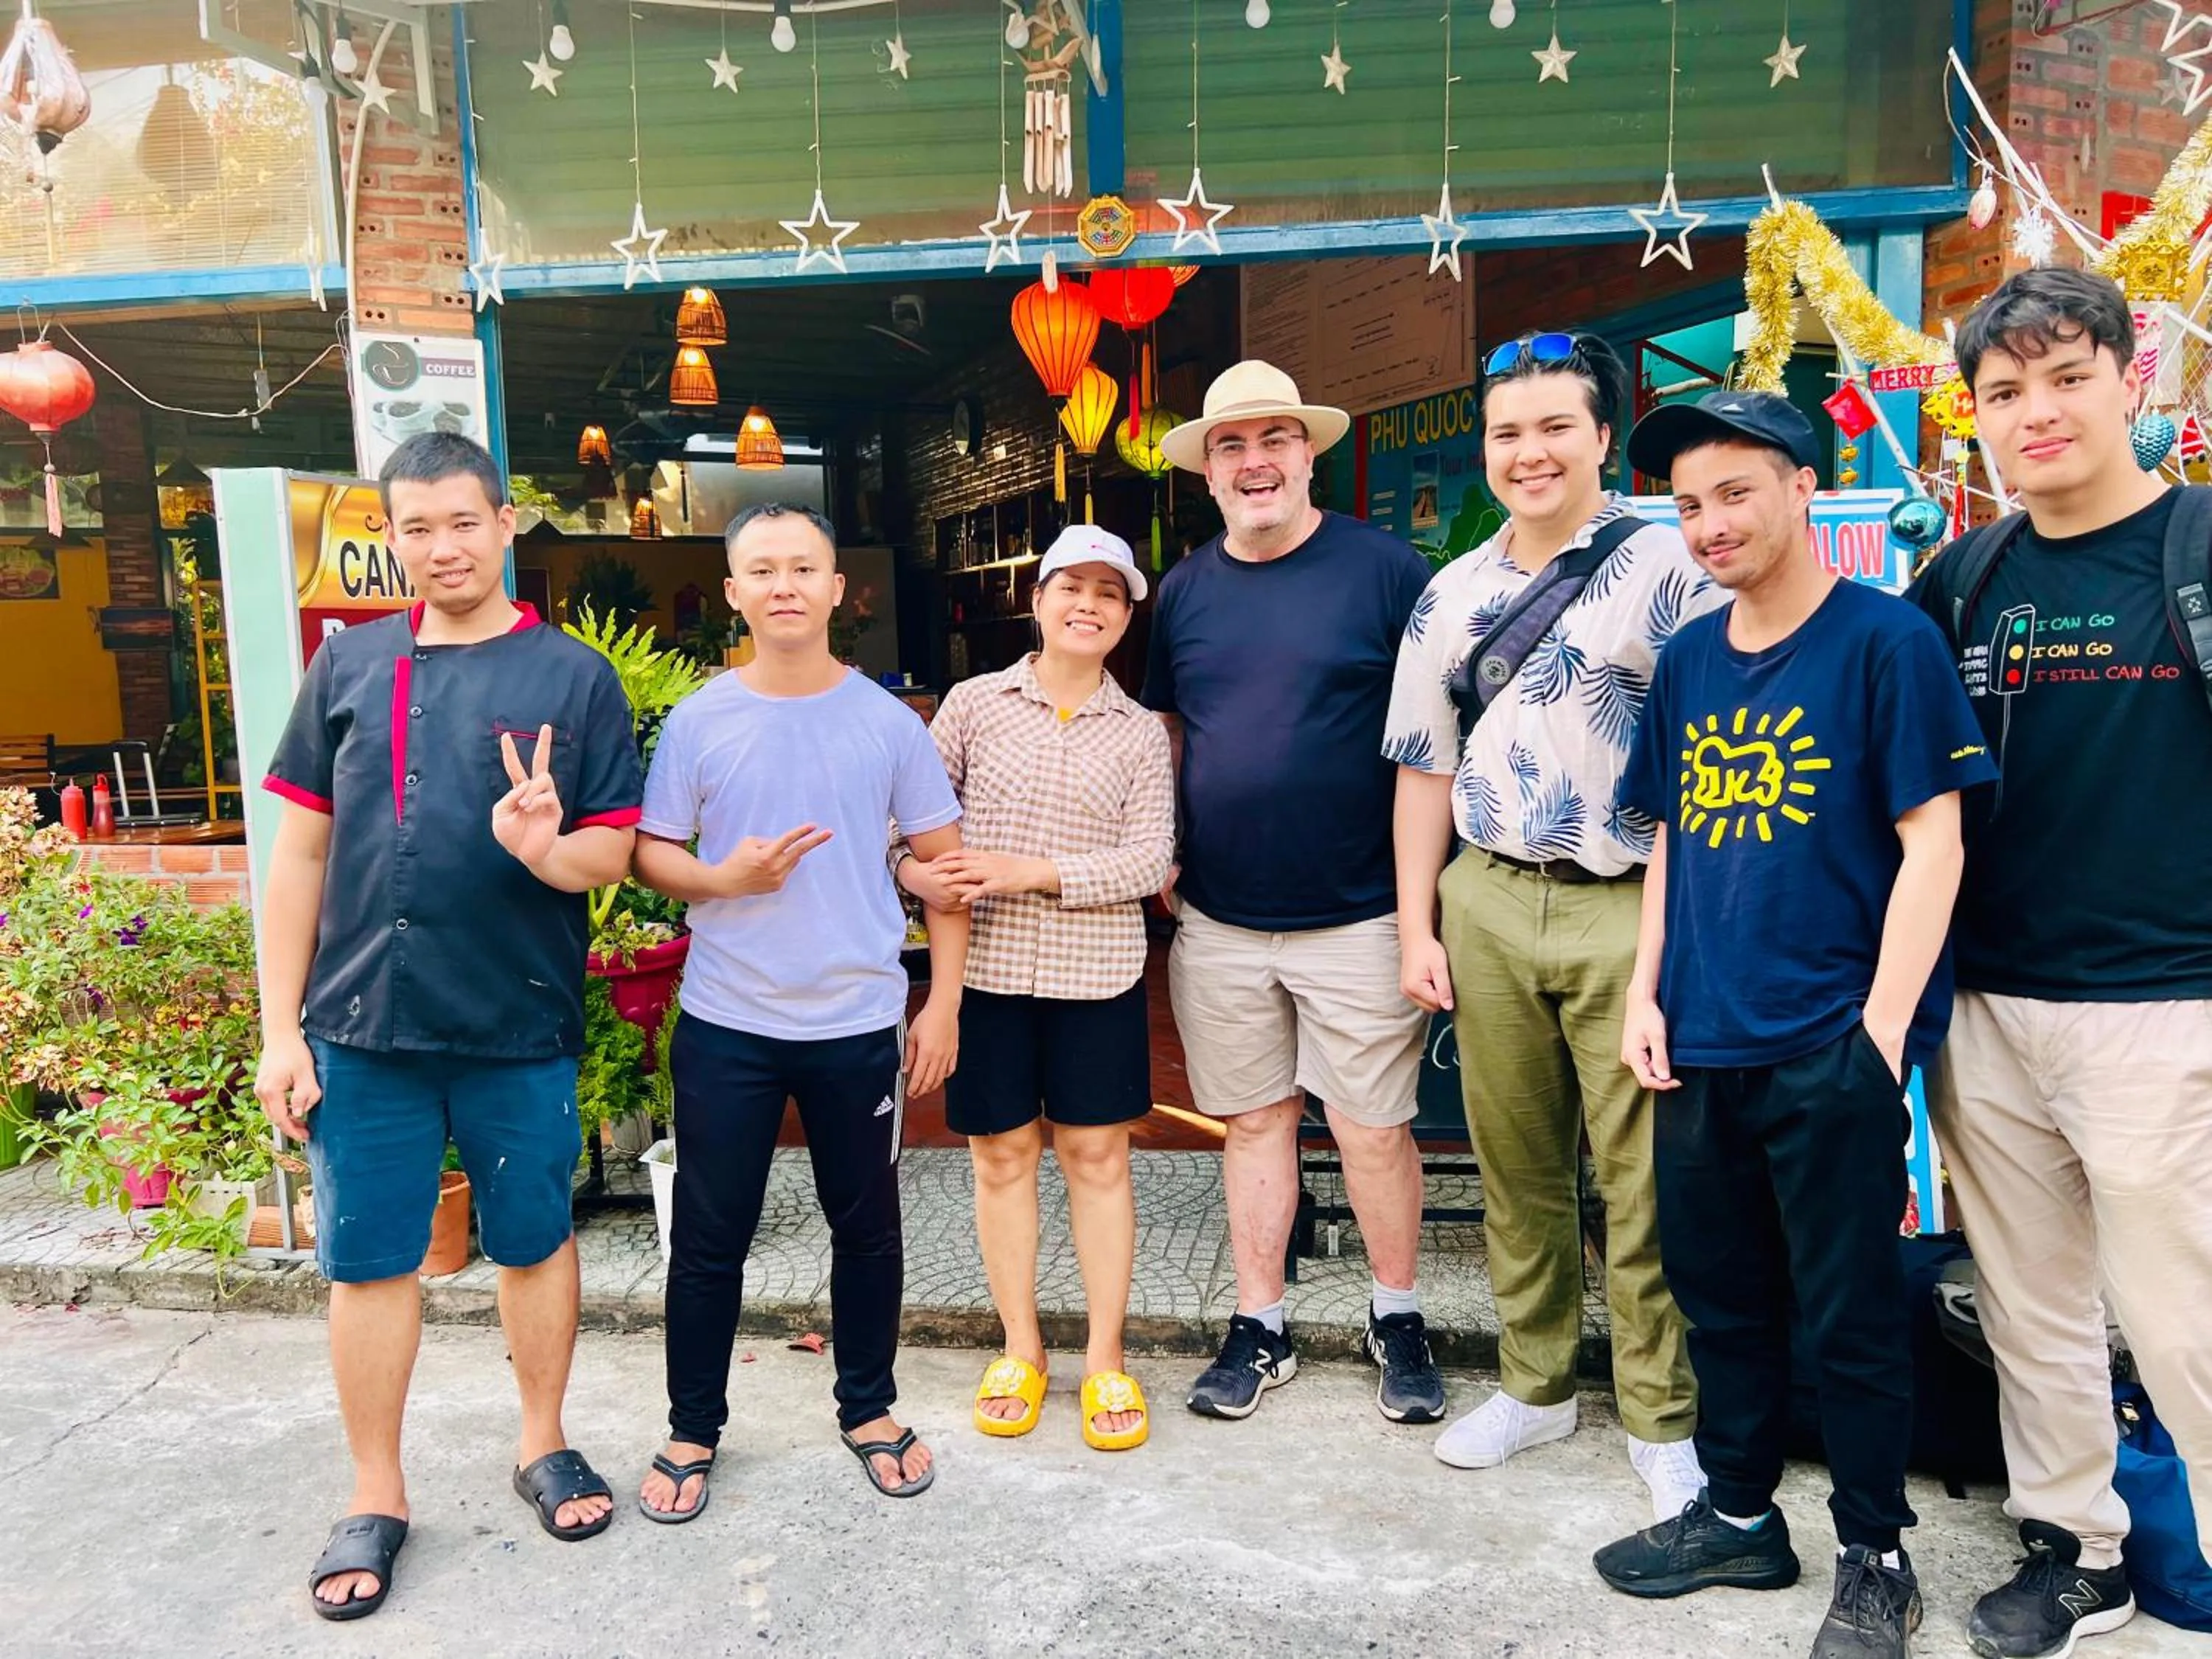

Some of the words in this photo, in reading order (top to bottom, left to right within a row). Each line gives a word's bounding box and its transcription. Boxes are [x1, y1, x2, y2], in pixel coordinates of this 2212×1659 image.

[426, 364, 475, 375] COFFEE
[1869, 365, 1935, 391] MERRY
[340, 540, 416, 598] CAN
[2035, 621, 2048, 631] I
[2051, 616, 2081, 630] CAN
[2088, 613, 2115, 627] GO
[2033, 647, 2045, 658] I
[2048, 644, 2079, 658] CAN
[2086, 642, 2112, 655] GO
[2034, 671, 2047, 682] I
[2049, 669, 2099, 682] STILL
[2105, 666, 2143, 680] CAN
[2151, 664, 2180, 678] GO
